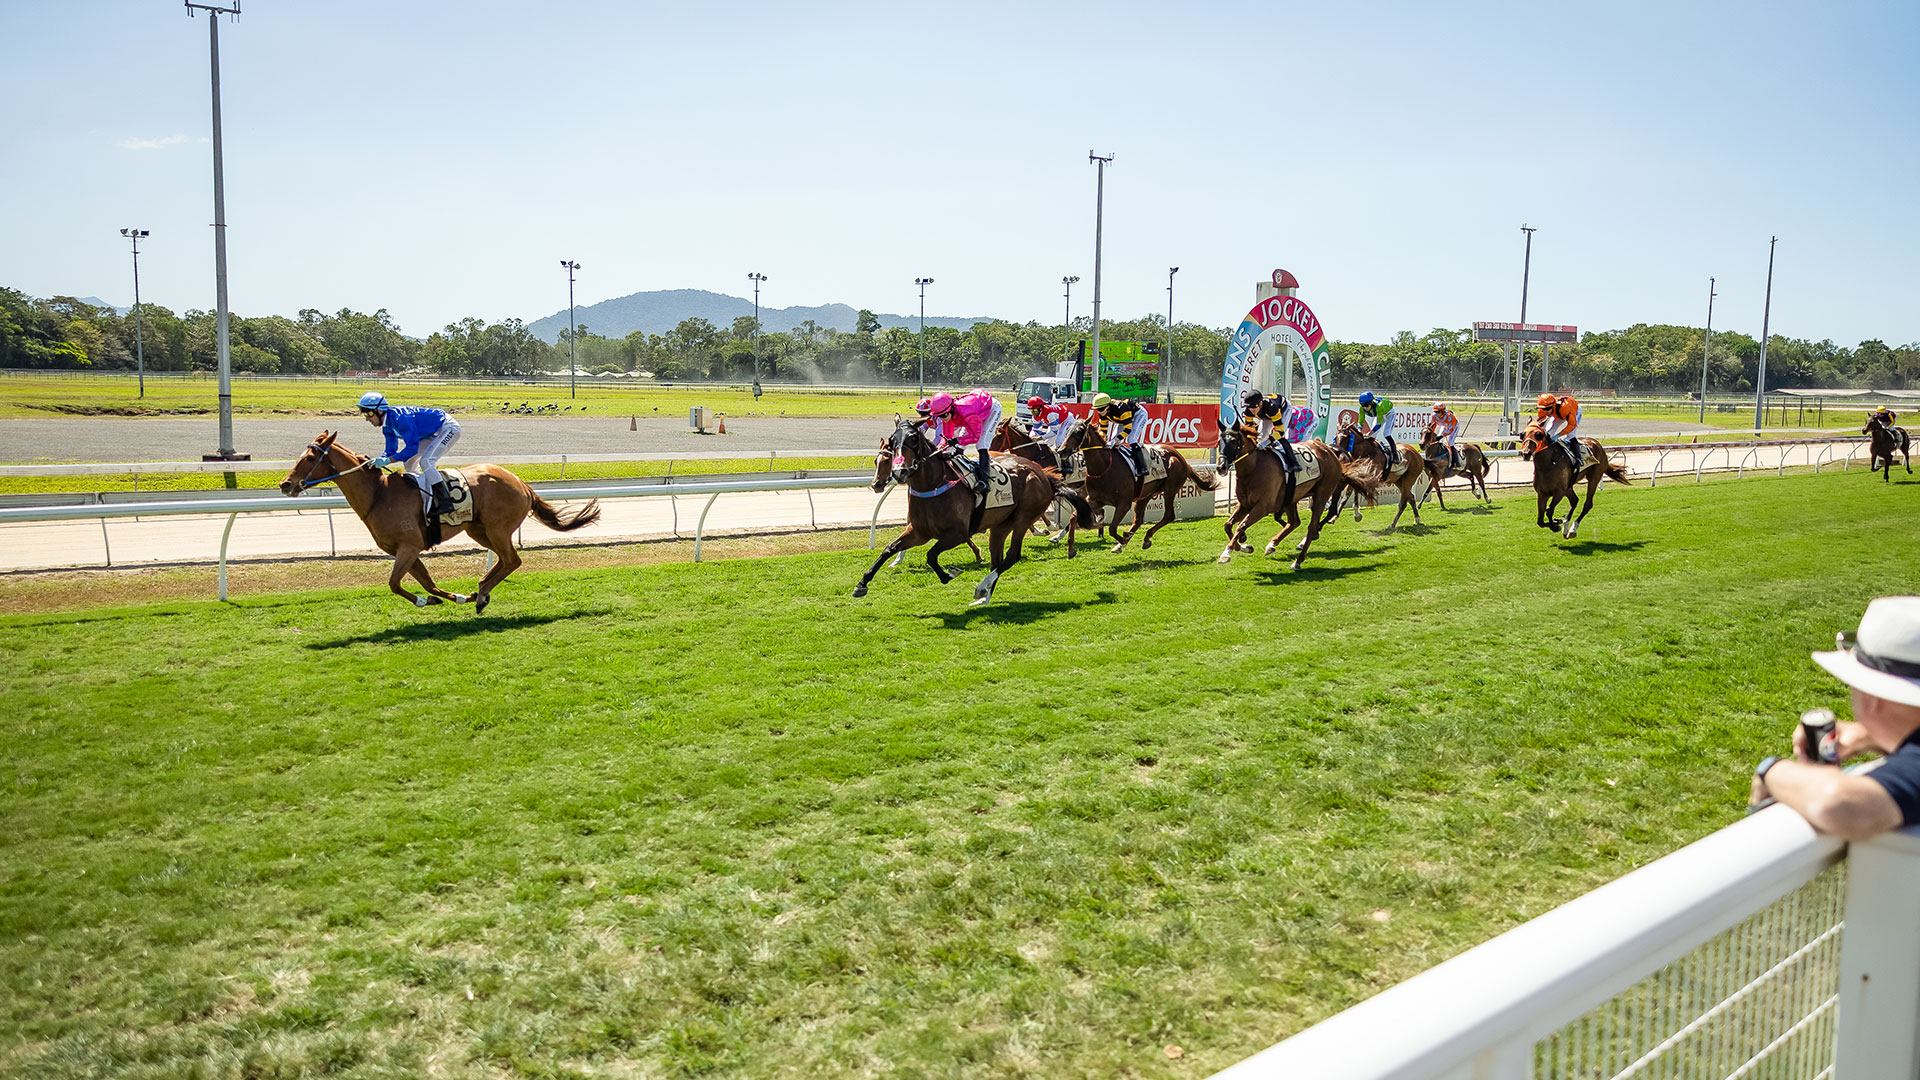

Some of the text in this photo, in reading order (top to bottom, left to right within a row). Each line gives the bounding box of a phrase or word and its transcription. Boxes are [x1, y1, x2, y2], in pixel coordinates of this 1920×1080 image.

[1261, 299, 1319, 338] JOCKEY
[1242, 340, 1263, 384] BERET
[1271, 334, 1292, 343] HOTEL
[1318, 352, 1331, 418] CLUB
[1394, 412, 1432, 428] ED BERET
[441, 431, 455, 446] HOLT
[1398, 432, 1422, 440] HOTEL
[446, 478, 467, 504] 5
